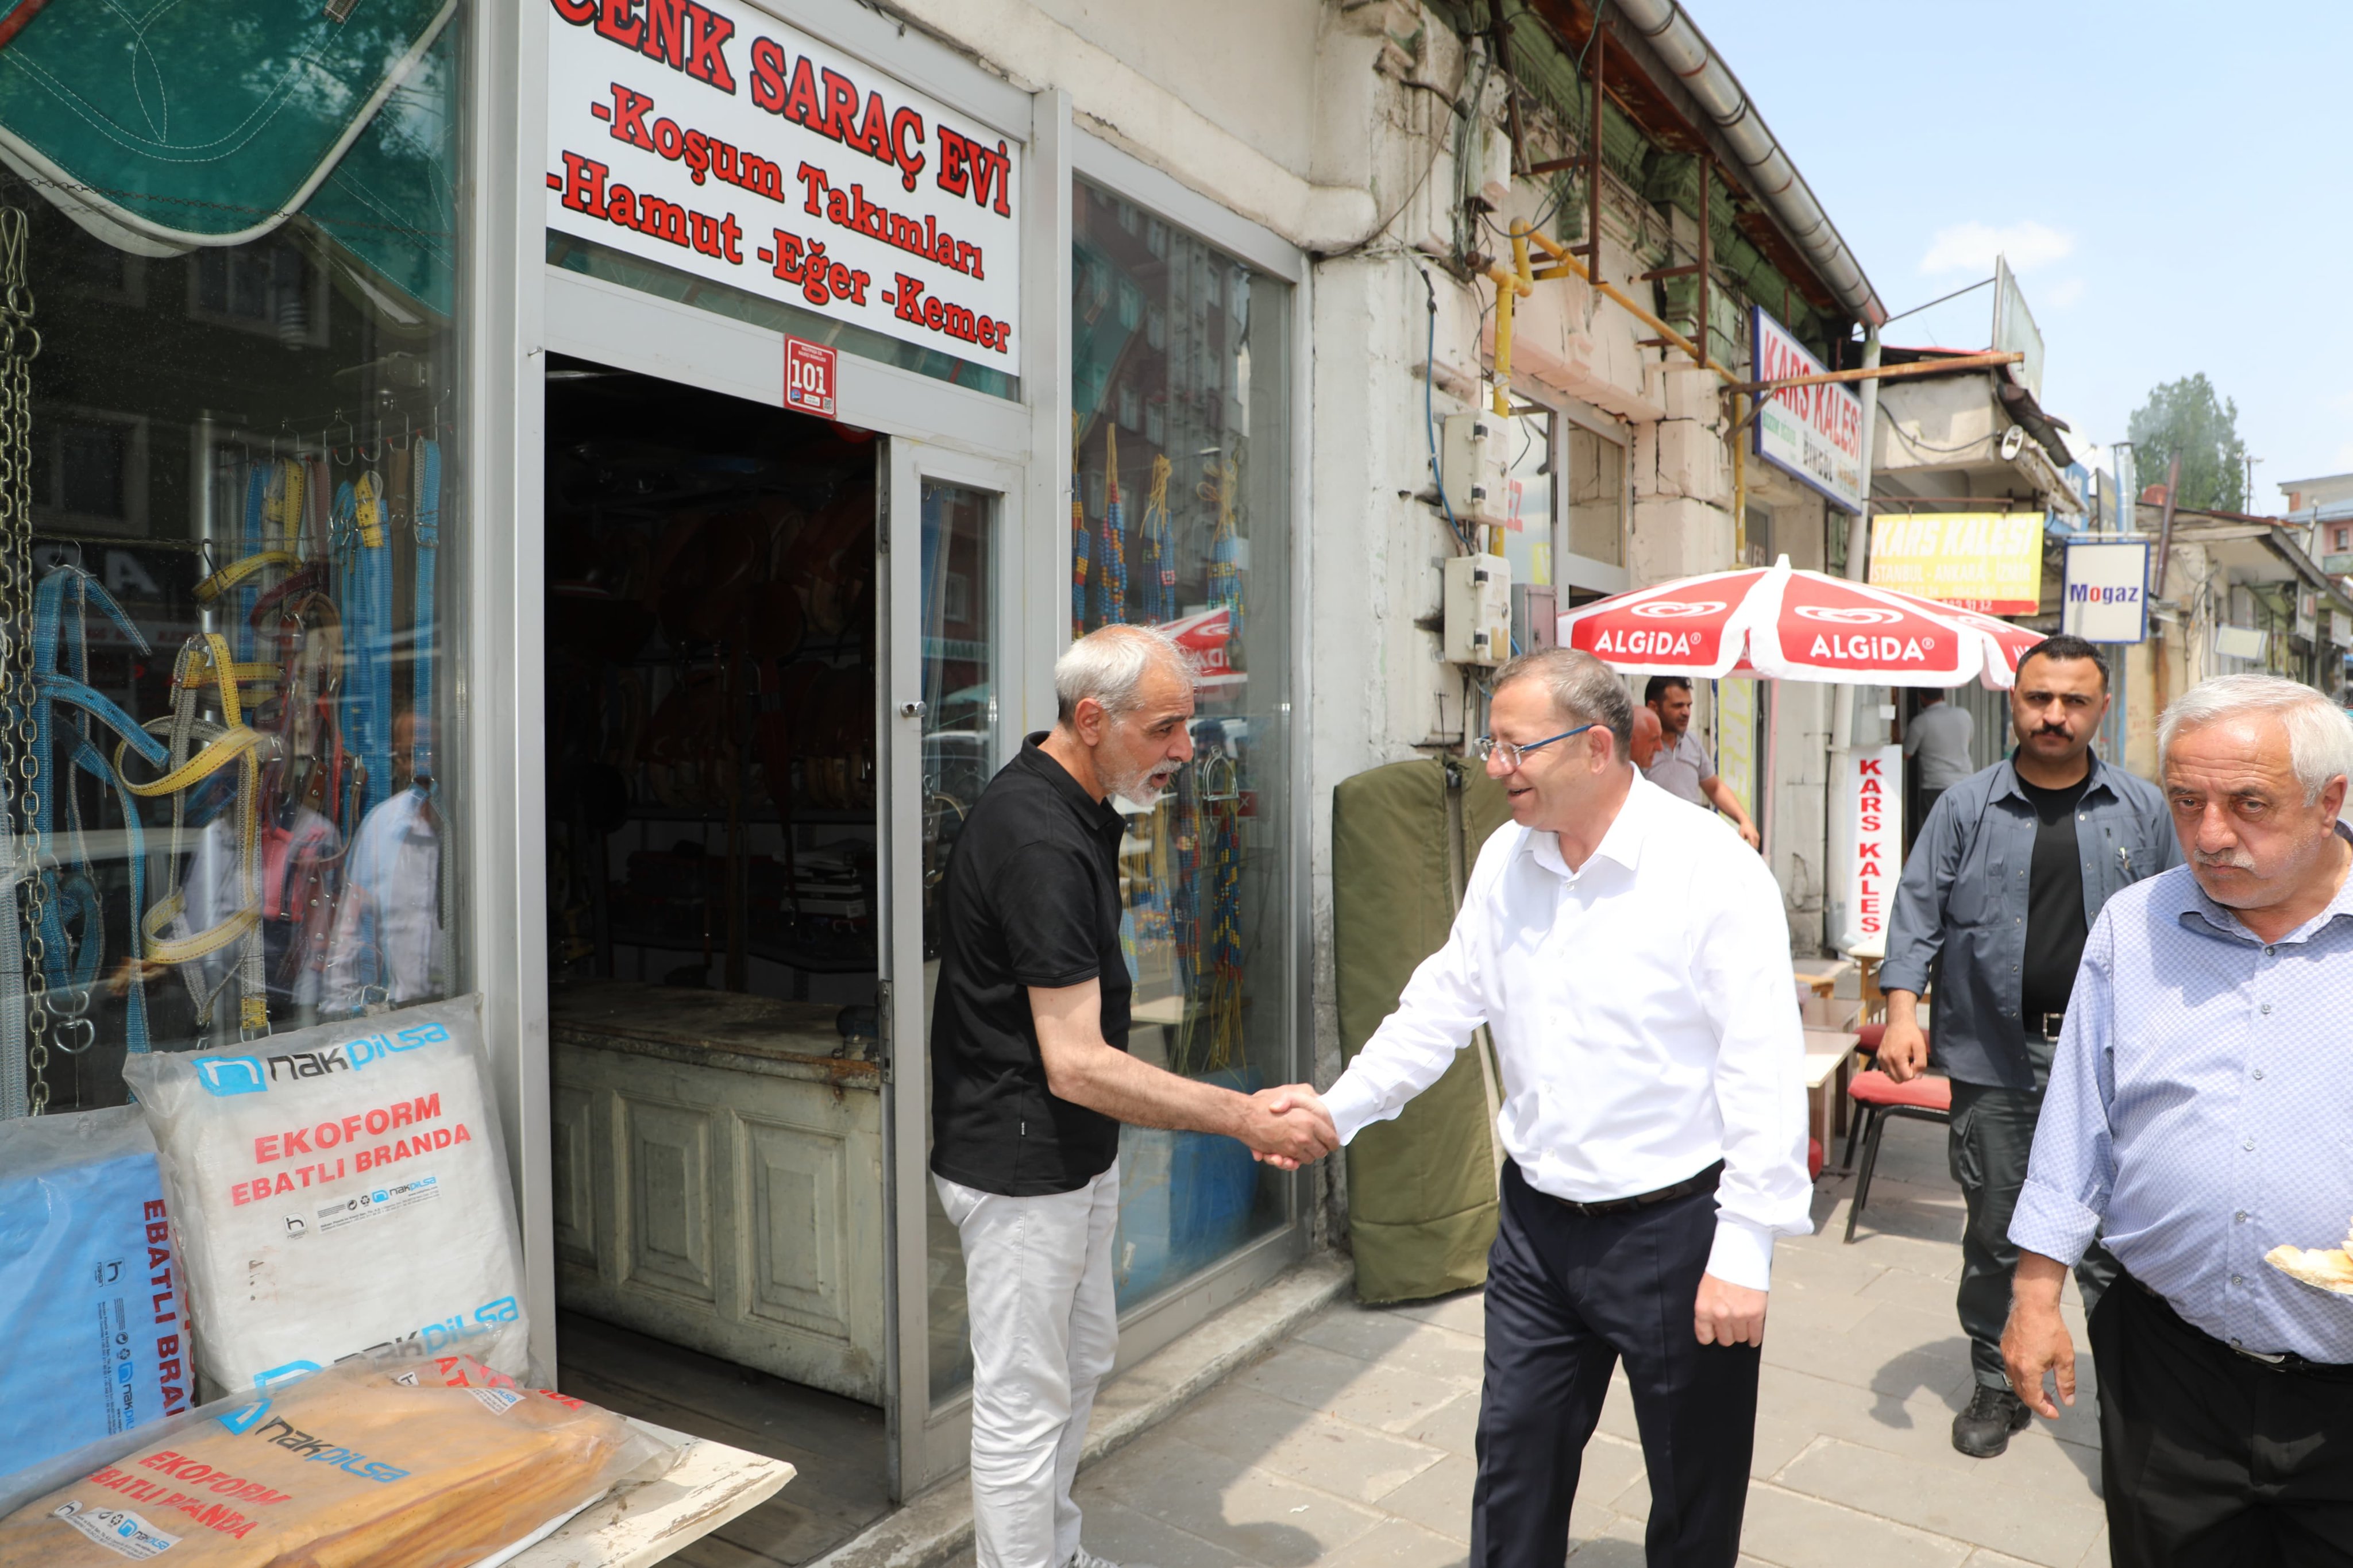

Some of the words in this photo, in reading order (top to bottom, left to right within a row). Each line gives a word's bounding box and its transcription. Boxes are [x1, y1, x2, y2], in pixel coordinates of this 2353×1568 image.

[750, 36, 925, 191] SARAÇ
[938, 125, 1011, 218] EVİ
[592, 83, 785, 203] -Koşum
[797, 161, 985, 280] Takımları
[547, 151, 743, 264] -Hamut
[758, 228, 871, 306] -Eğer
[882, 274, 1011, 353] -Kemer
[792, 359, 826, 395] 101
[1761, 330, 1811, 422] KARS
[1872, 521, 1939, 556] KARS
[2070, 584, 2139, 605] Mogaz
[1859, 759, 1883, 832] KARS
[1859, 843, 1882, 939] KALES
[231, 1158, 345, 1207] EBATLI
[356, 1123, 472, 1173] BRANDA
[254, 1092, 442, 1164] EKOFORM
[144, 1199, 177, 1324] EBATLI
[138, 1451, 292, 1507] EKOFORM
